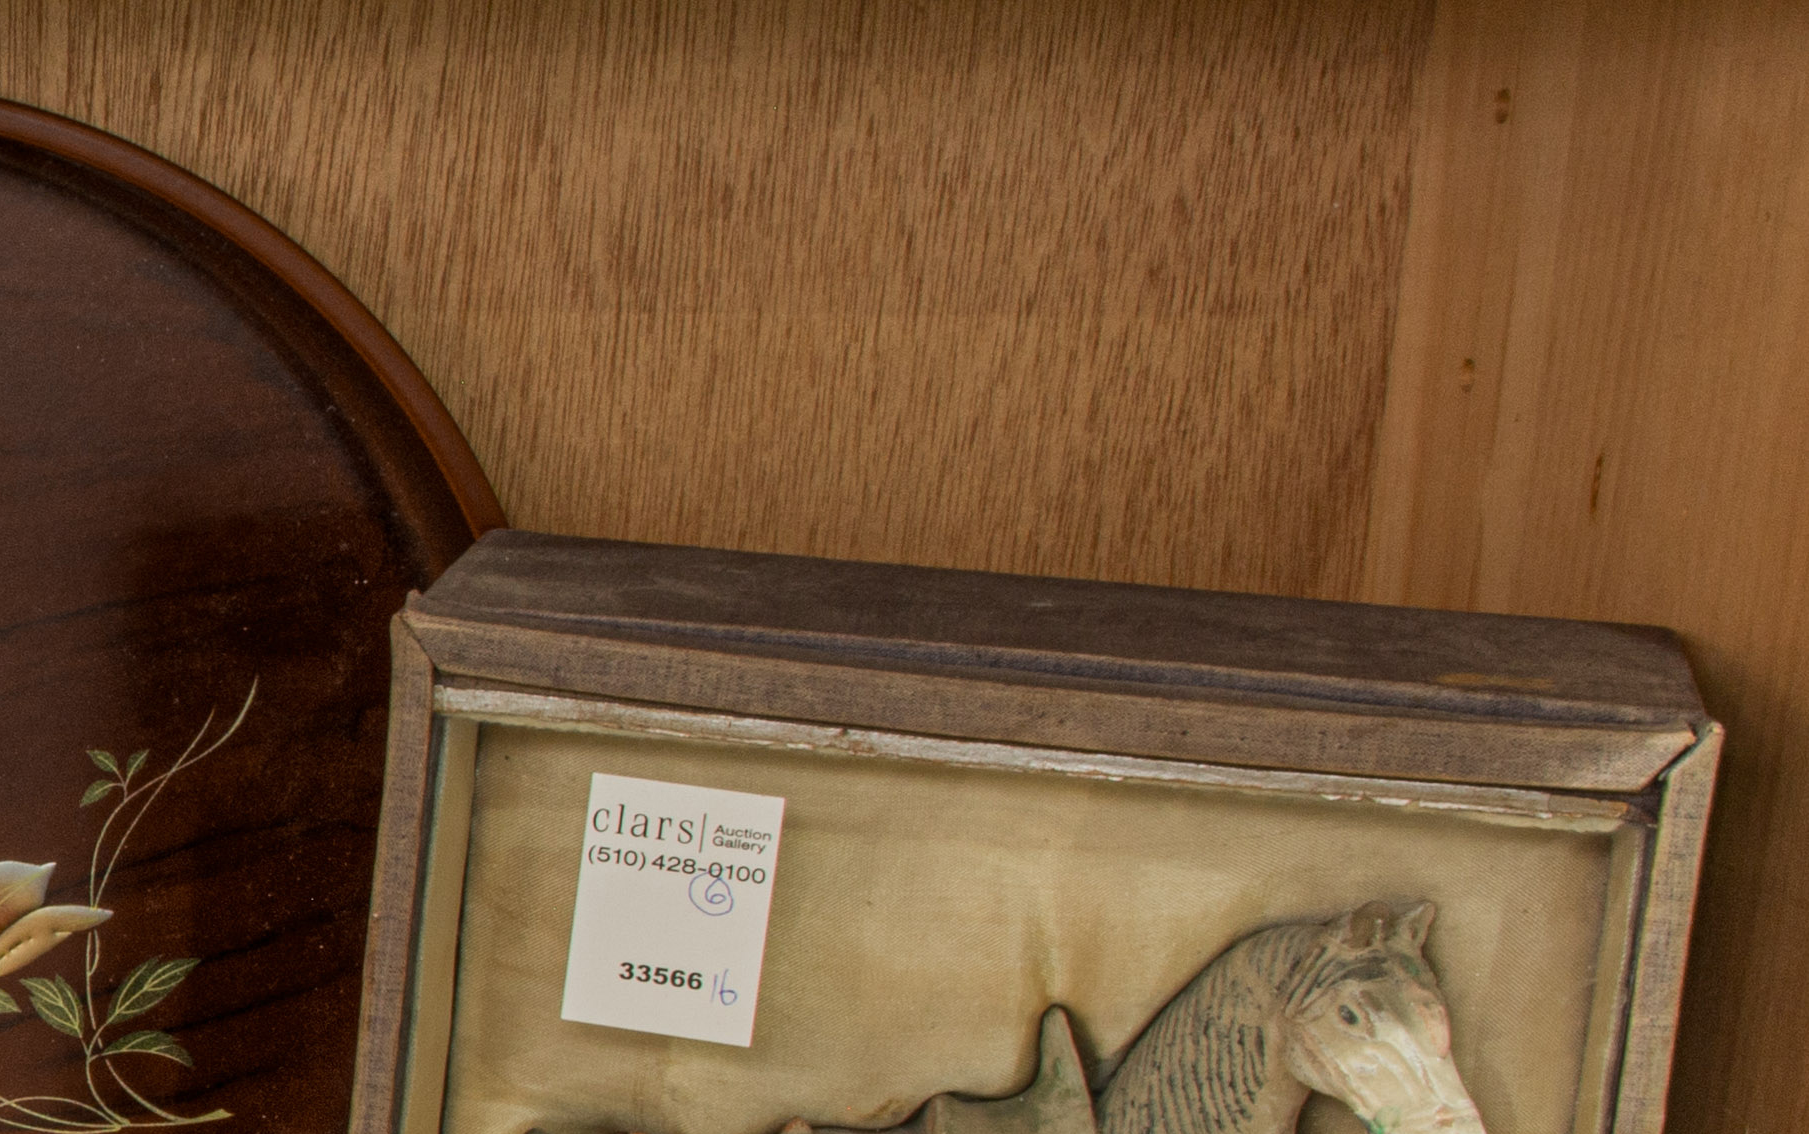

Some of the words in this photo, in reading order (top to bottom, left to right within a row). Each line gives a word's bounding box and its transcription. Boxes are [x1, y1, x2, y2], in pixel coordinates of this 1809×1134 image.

[592, 804, 694, 844] clars
[714, 824, 772, 842] Auction
[712, 835, 766, 853] Gallery
[588, 845, 646, 871] (510)
[651, 854, 766, 884] 428-0100
[619, 962, 703, 990] 33566
